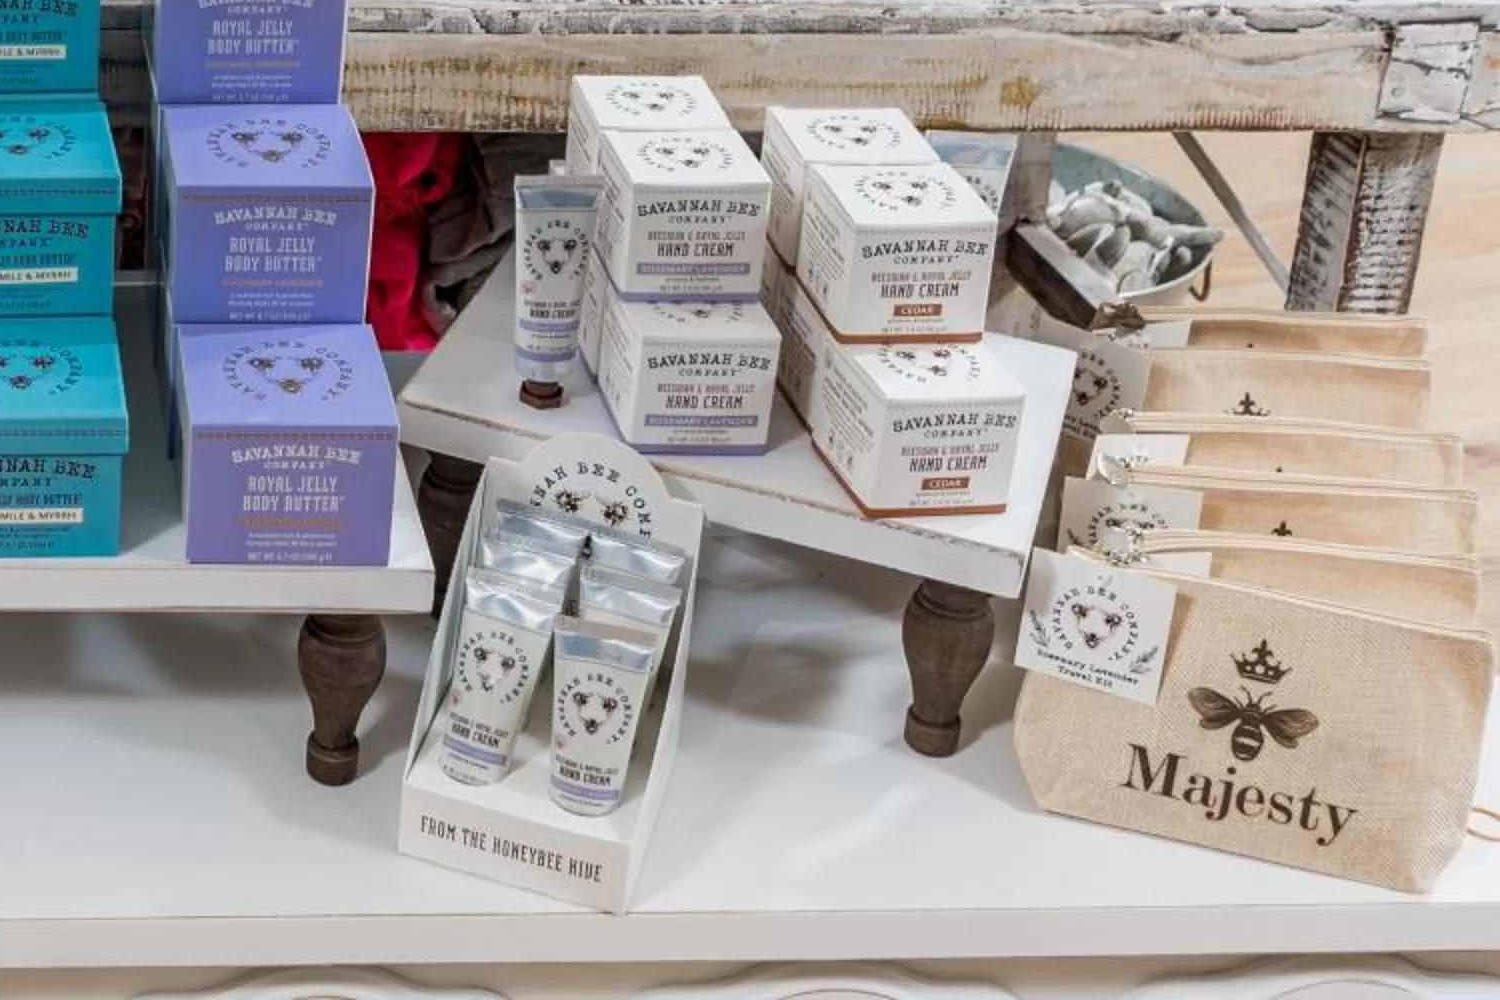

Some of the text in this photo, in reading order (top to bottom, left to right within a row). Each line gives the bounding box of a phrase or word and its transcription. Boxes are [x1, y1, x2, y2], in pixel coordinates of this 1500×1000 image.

[212, 19, 293, 36] ROYAL JELLY
[207, 39, 296, 54] BODY BUTTER
[213, 205, 338, 226] SAVANNAH BEE
[637, 199, 761, 217] SAVANNAH BEE
[49, 219, 90, 239] BEE
[229, 237, 315, 253] ROYAL JELLY
[657, 241, 734, 257] HAND CREAM
[862, 239, 989, 260] SAVANNAH BEE
[225, 256, 316, 272] BODY BUTTER
[880, 282, 960, 299] HAND CREAM
[901, 306, 935, 316] CEDAR
[647, 353, 772, 371] SAVANNAH BEE
[665, 394, 743, 410] HAND CREAM
[893, 413, 1017, 433] SAVANNAH BEE
[231, 444, 362, 465] SAVANNAH BEE
[52, 460, 97, 480] BEE
[578, 461, 621, 484] BEE
[909, 455, 987, 473] HAND CREAM
[247, 476, 337, 492] ROYAL JELLY
[929, 478, 962, 489] CEDAR
[243, 496, 339, 512] BODY BUTTER
[1037, 648, 1140, 686] Rosemary Lavender
[1057, 667, 1092, 685] Travel
[1120, 742, 1359, 846] Majesty
[420, 814, 602, 883] FROM THE HONEYBEE HIVE
